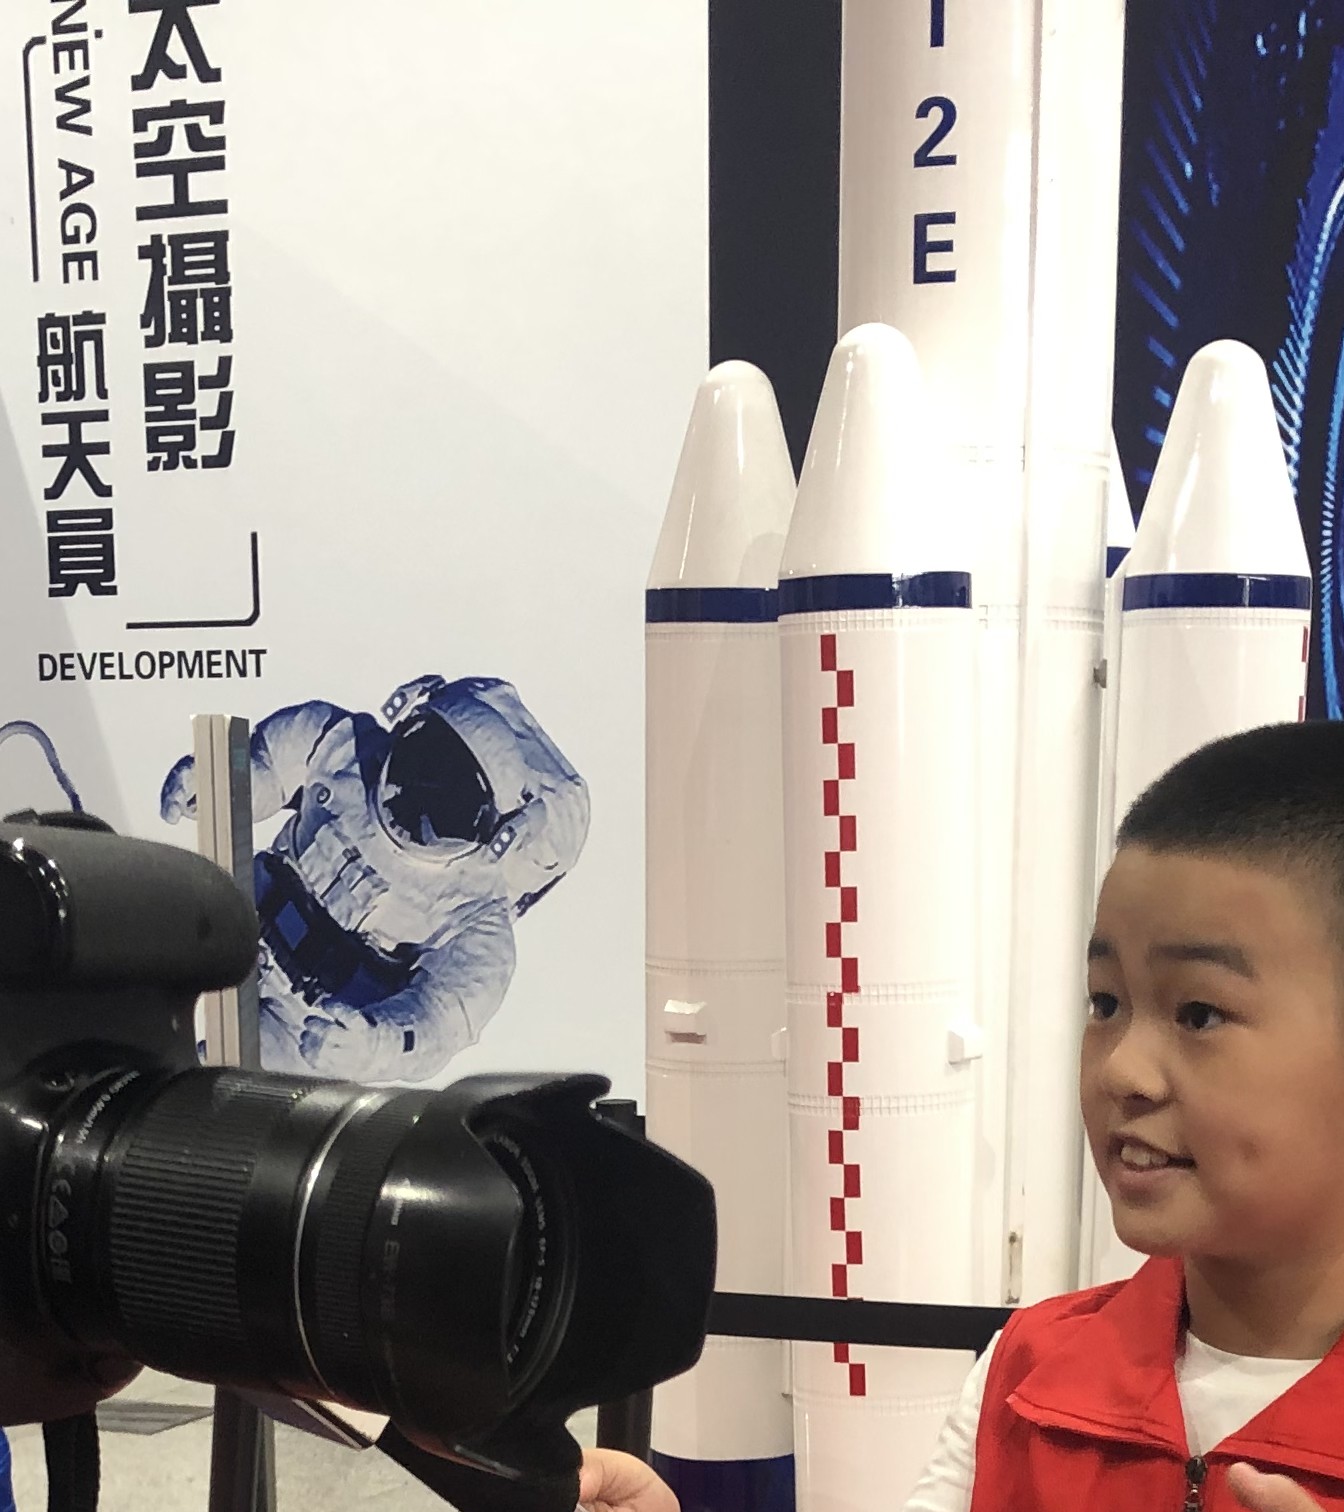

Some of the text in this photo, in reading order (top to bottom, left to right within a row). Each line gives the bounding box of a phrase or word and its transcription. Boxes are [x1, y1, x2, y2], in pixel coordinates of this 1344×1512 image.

[50, 0, 99, 284] NEW AGE
[127, 0, 236, 471] 太空攝影
[36, 310, 118, 598] 航天員
[38, 648, 267, 682] DEVELOPMENT
